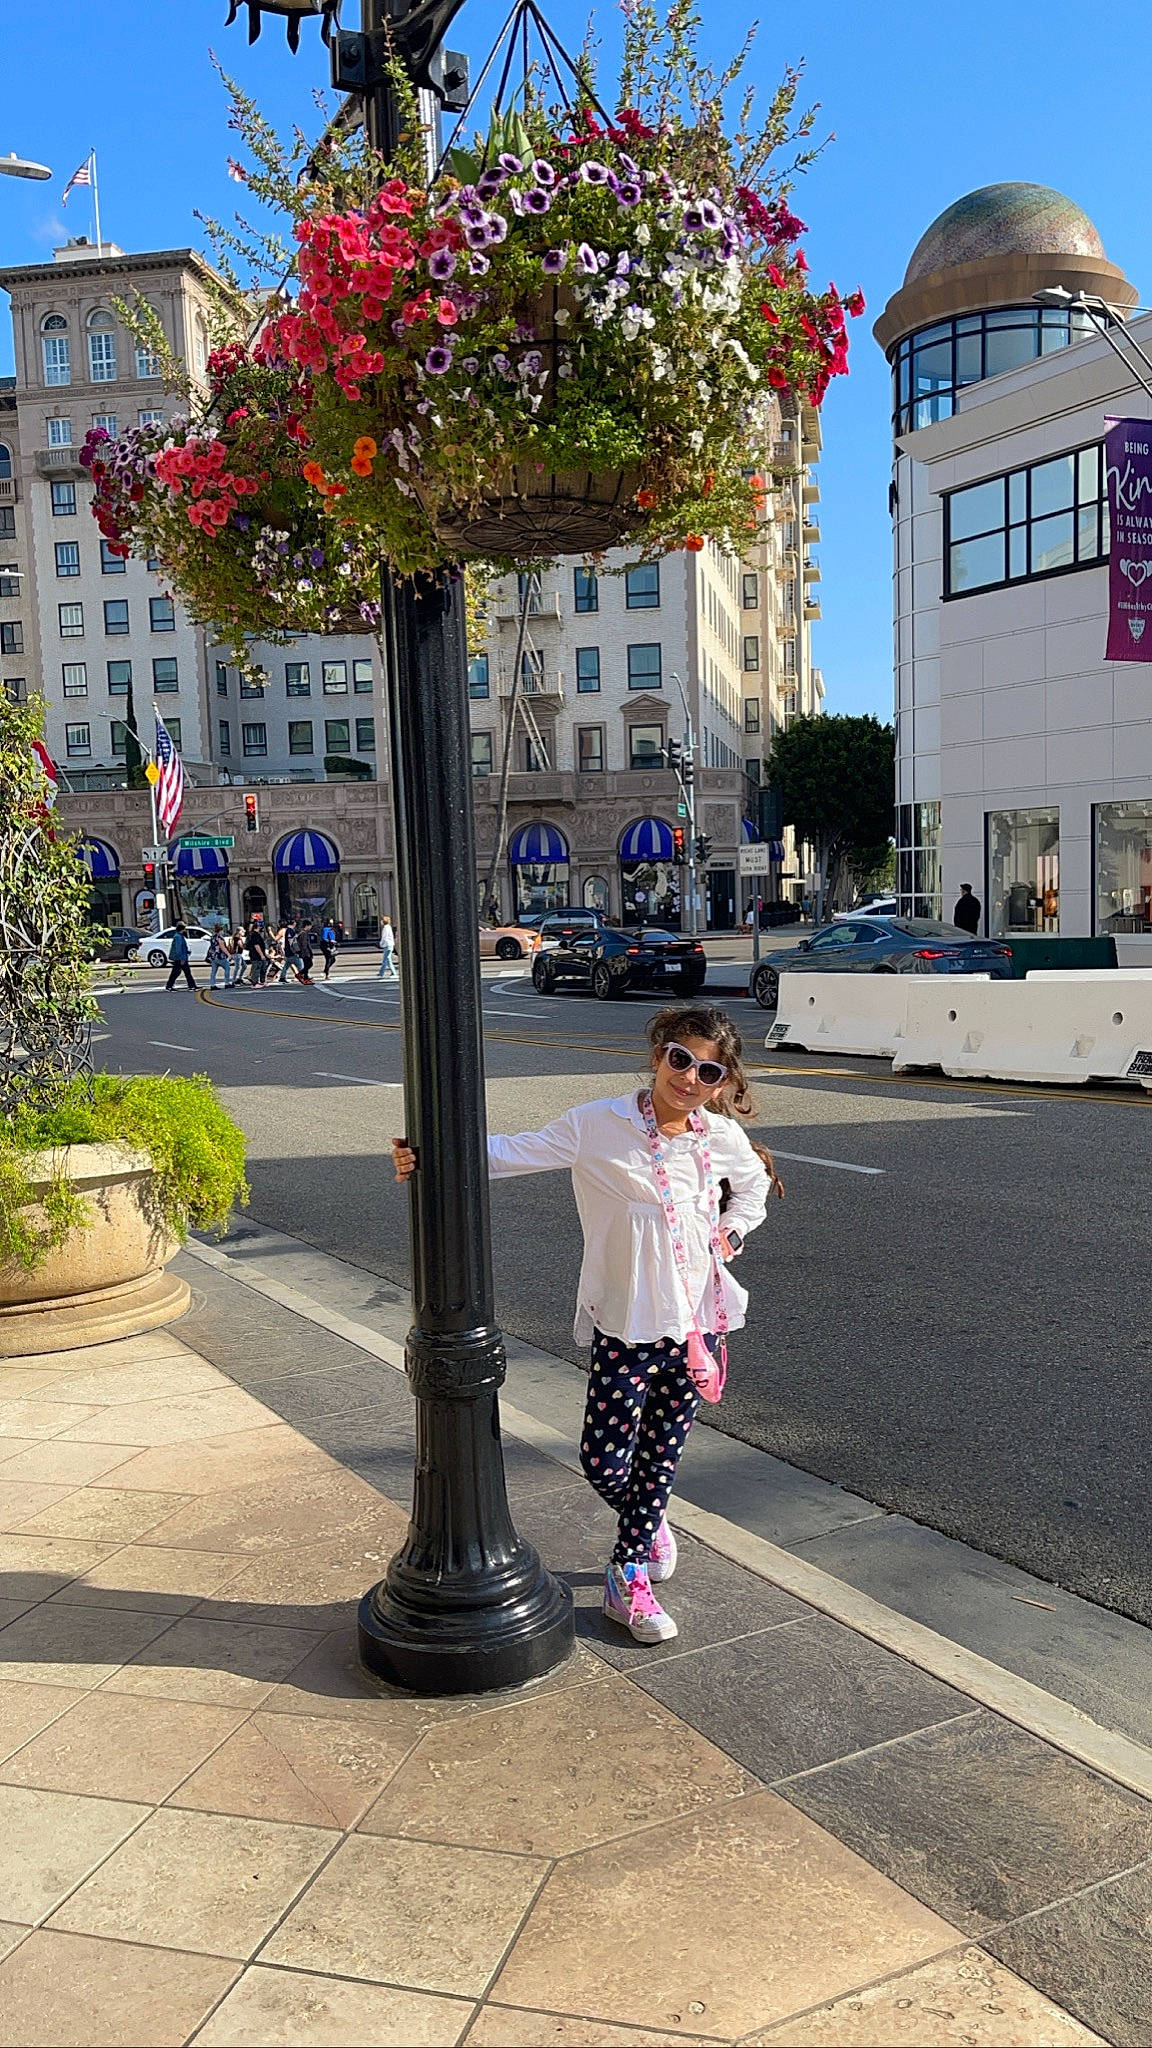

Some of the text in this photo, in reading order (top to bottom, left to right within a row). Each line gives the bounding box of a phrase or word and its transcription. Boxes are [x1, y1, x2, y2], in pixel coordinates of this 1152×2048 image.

[1124, 441, 1149, 455] BEING
[1117, 513, 1124, 526] IS
[1116, 530, 1125, 543] IN
